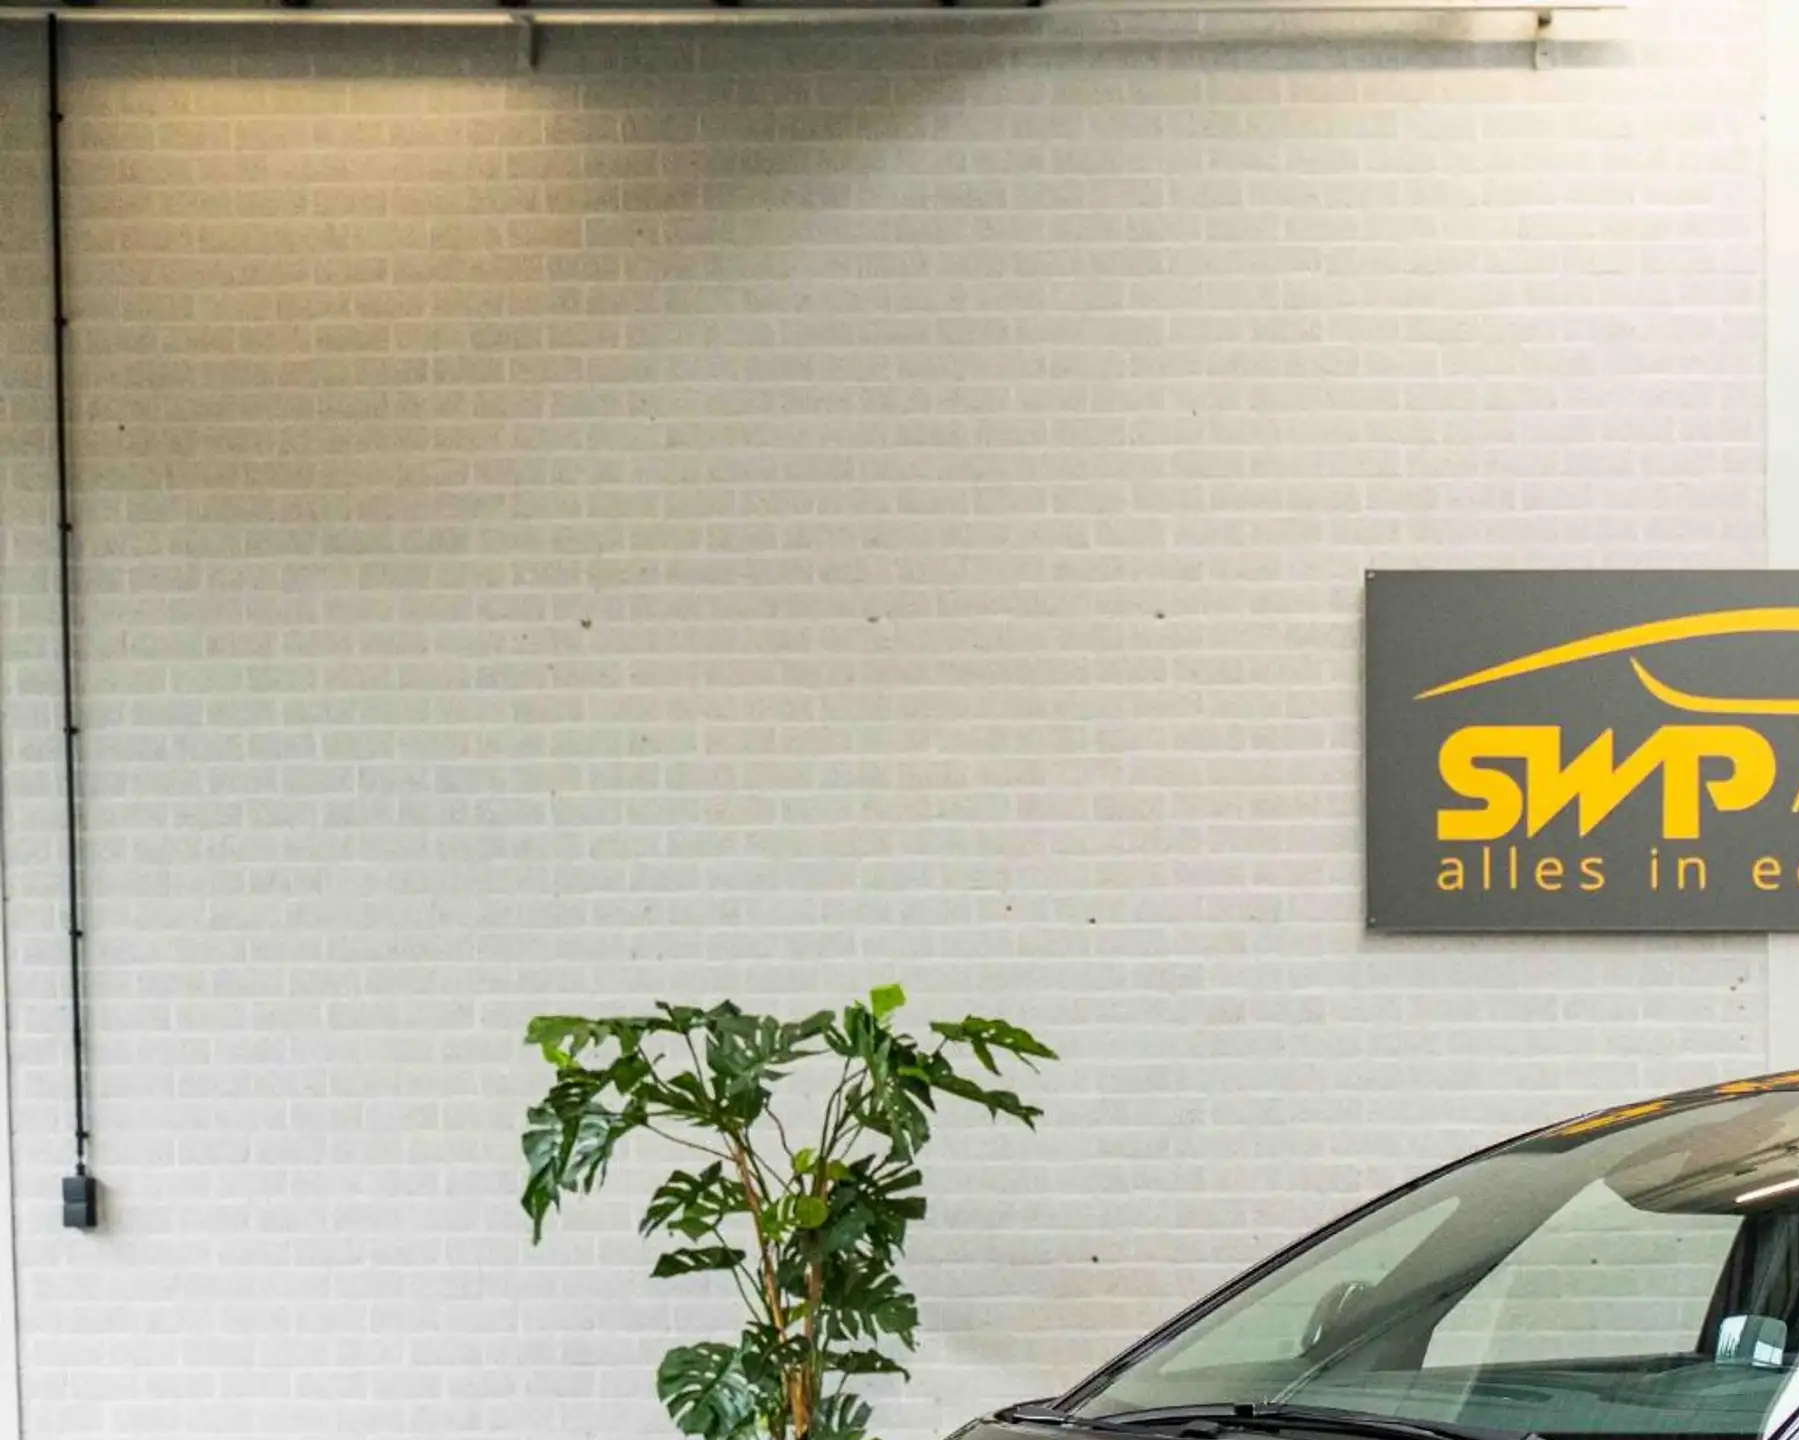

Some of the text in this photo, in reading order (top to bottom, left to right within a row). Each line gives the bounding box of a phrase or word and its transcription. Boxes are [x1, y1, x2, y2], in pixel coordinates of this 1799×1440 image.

[1436, 724, 1777, 841] SWP
[1436, 844, 1607, 891] alles
[1649, 846, 1707, 889] in
